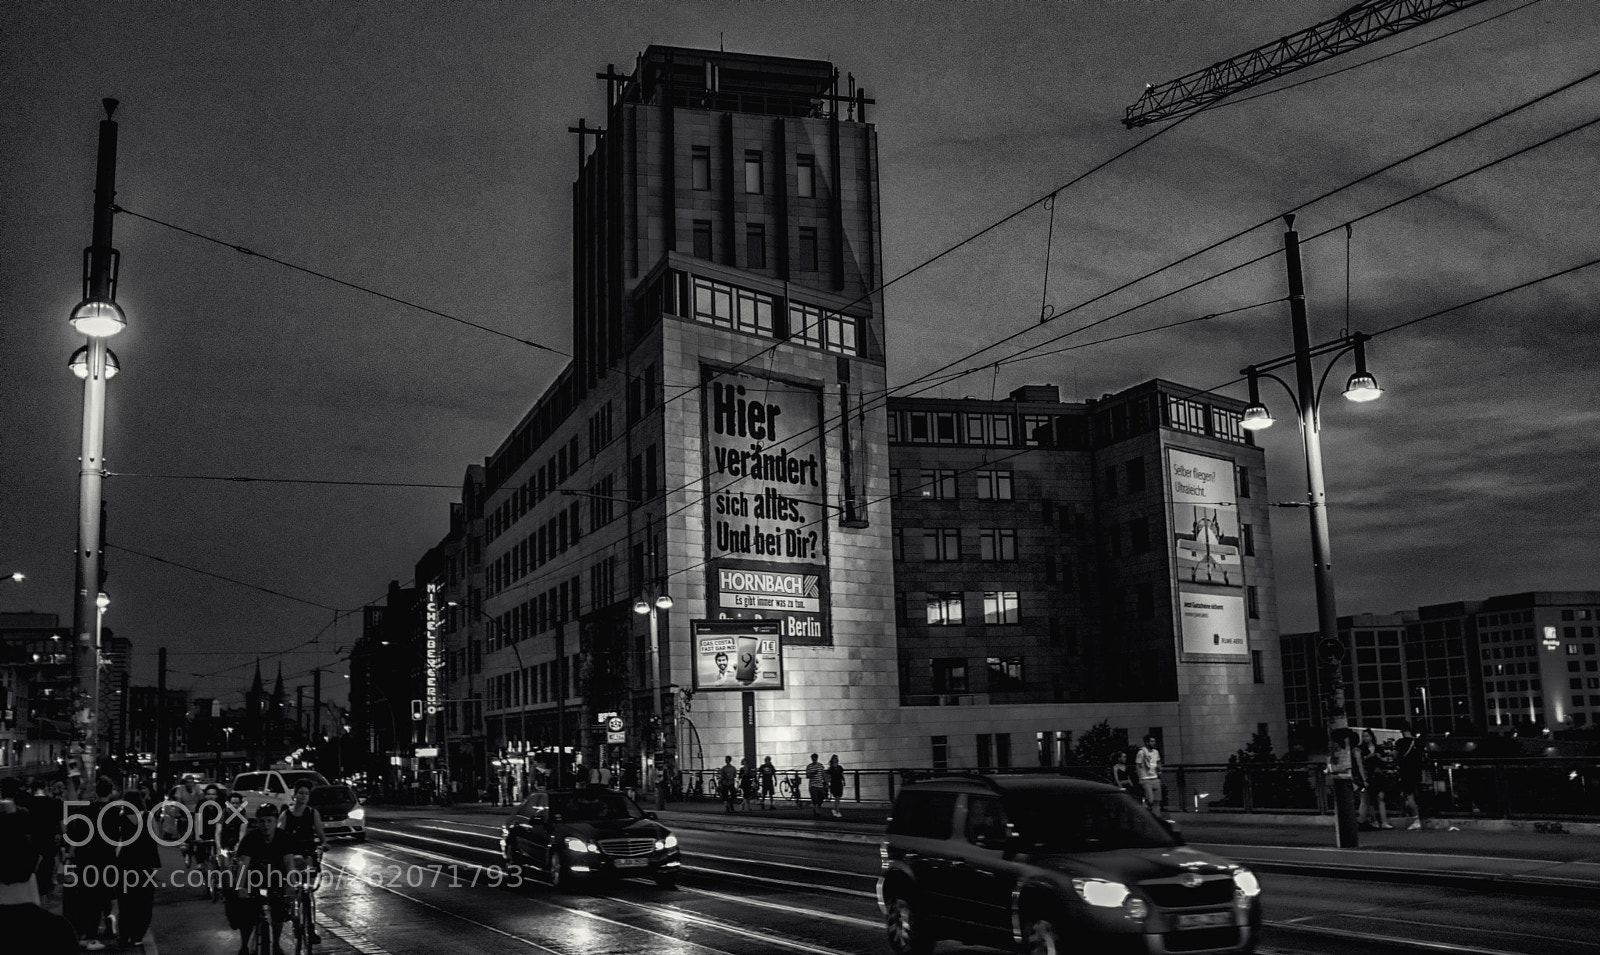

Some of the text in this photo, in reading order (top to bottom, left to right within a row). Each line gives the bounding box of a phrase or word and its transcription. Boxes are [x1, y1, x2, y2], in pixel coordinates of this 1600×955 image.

[714, 382, 781, 441] Hier
[714, 444, 818, 487] verändert
[1173, 463, 1216, 483] Selber fliegen?
[1174, 481, 1206, 497] Ultraleicht.
[717, 487, 805, 523] sich alles.
[716, 521, 817, 559] Und bei Dir?
[720, 571, 803, 596] HORNBACH
[735, 595, 742, 605] Es
[744, 596, 756, 608] gibt
[787, 600, 794, 608] zu
[788, 616, 821, 638] Berlin
[762, 641, 775, 651] 1€
